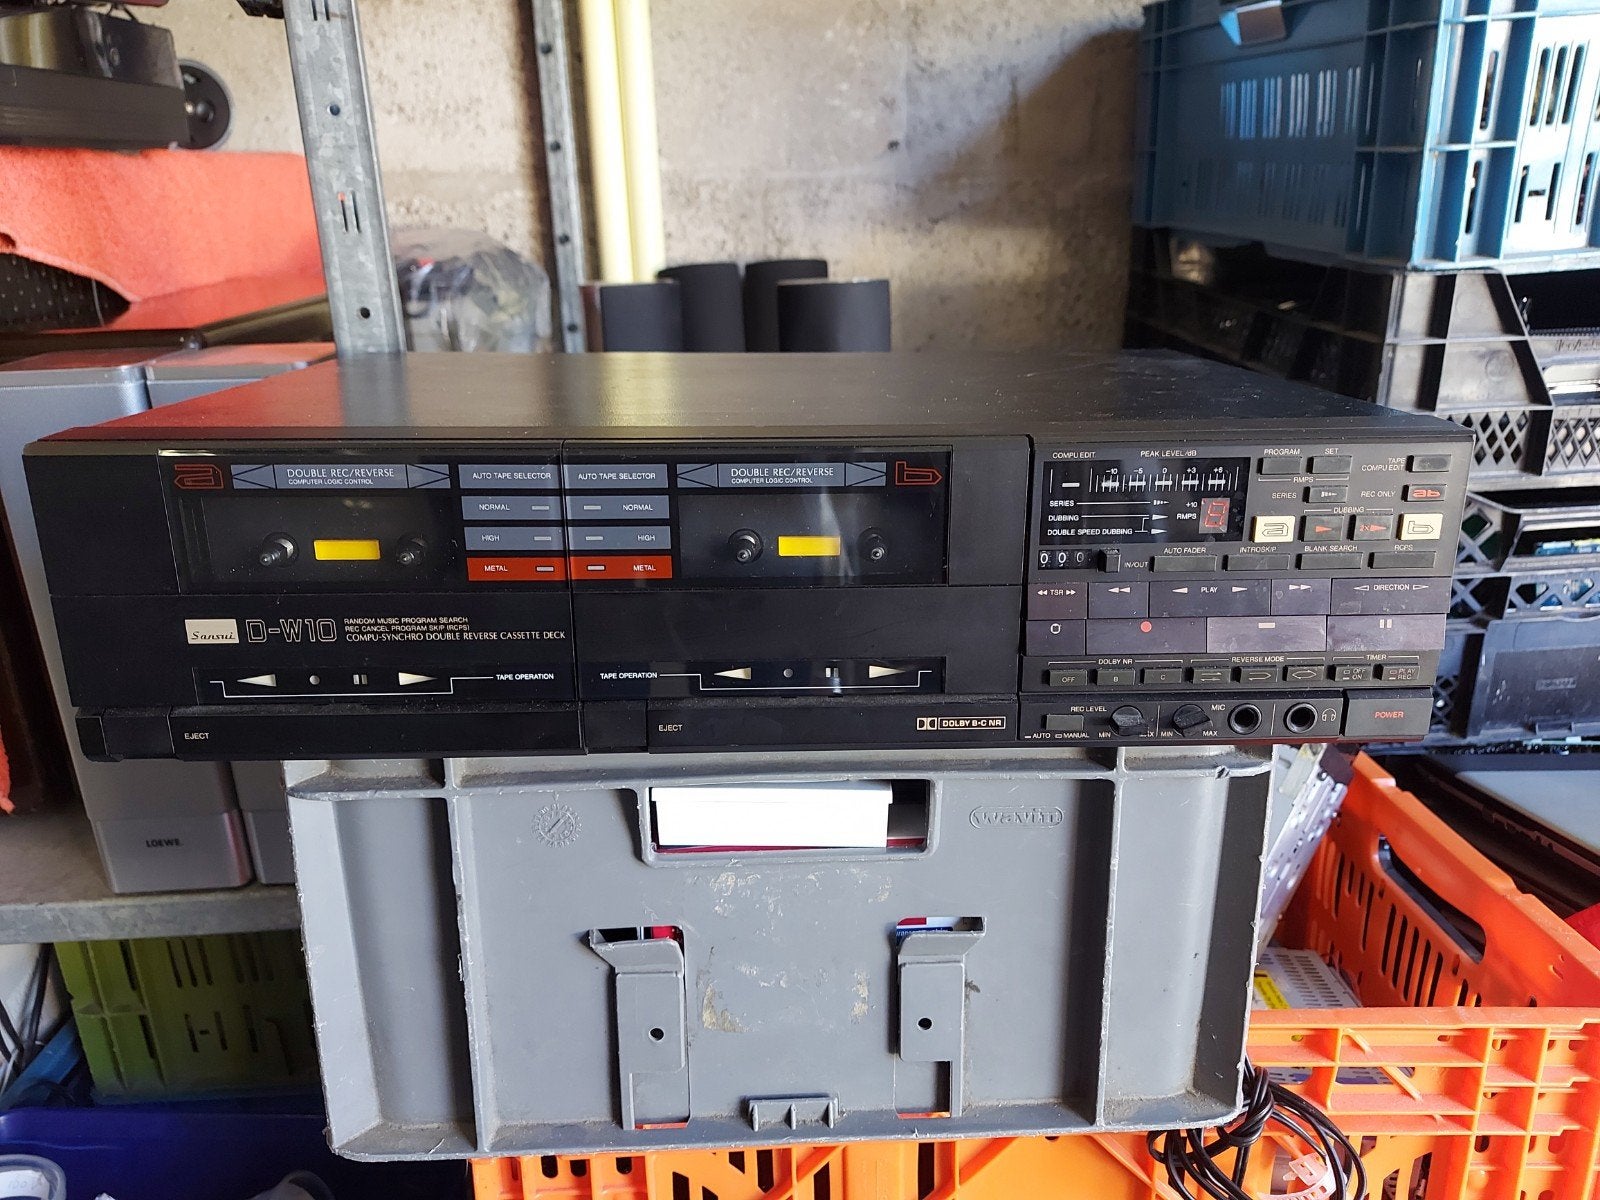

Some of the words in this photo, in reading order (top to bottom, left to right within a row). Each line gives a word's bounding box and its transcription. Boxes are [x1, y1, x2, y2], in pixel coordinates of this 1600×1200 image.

[1079, 451, 1096, 459] EDIT
[1161, 450, 1197, 458] LEVEL/dB
[1388, 457, 1405, 465] TAPE
[731, 468, 769, 477] DOUBLE
[772, 467, 834, 477] REC/REVERSE
[1361, 464, 1387, 472] COMPU
[286, 468, 328, 478] DOUBLE
[330, 468, 395, 478] REC/REVERSE
[472, 472, 492, 480] AUTO
[494, 472, 512, 480] TAPE
[513, 472, 552, 480] SELECTOR
[618, 472, 656, 480] SELECTOR
[288, 478, 323, 486] COMPUTER
[1377, 490, 1396, 498] ONLY
[478, 503, 510, 512] NORMAL
[622, 503, 654, 512] NORMAL
[1048, 515, 1080, 523] DUBBING
[1077, 528, 1101, 536] SPEED
[481, 534, 500, 542] HIGH
[637, 534, 656, 542] HIGH
[1183, 546, 1206, 554] FADER
[1304, 545, 1328, 553] BLANK
[1040, 552, 1049, 564] 0
[1058, 552, 1067, 563] 0
[484, 564, 509, 573] METAL
[633, 564, 657, 572] METAL
[1201, 586, 1218, 594] PLAY
[245, 619, 337, 643] D-W10
[191, 632, 236, 640] Sansui
[346, 633, 424, 642] COMPU-SYNCHRO
[425, 632, 461, 641] DOUBLE
[463, 632, 498, 640] REVERSE
[500, 631, 541, 640] CASSETTE
[543, 631, 566, 639] DECK
[1231, 655, 1263, 663] REVERSE
[1374, 711, 1404, 719] POWER
[658, 724, 683, 733] EJECT
[184, 732, 209, 740] EJECT
